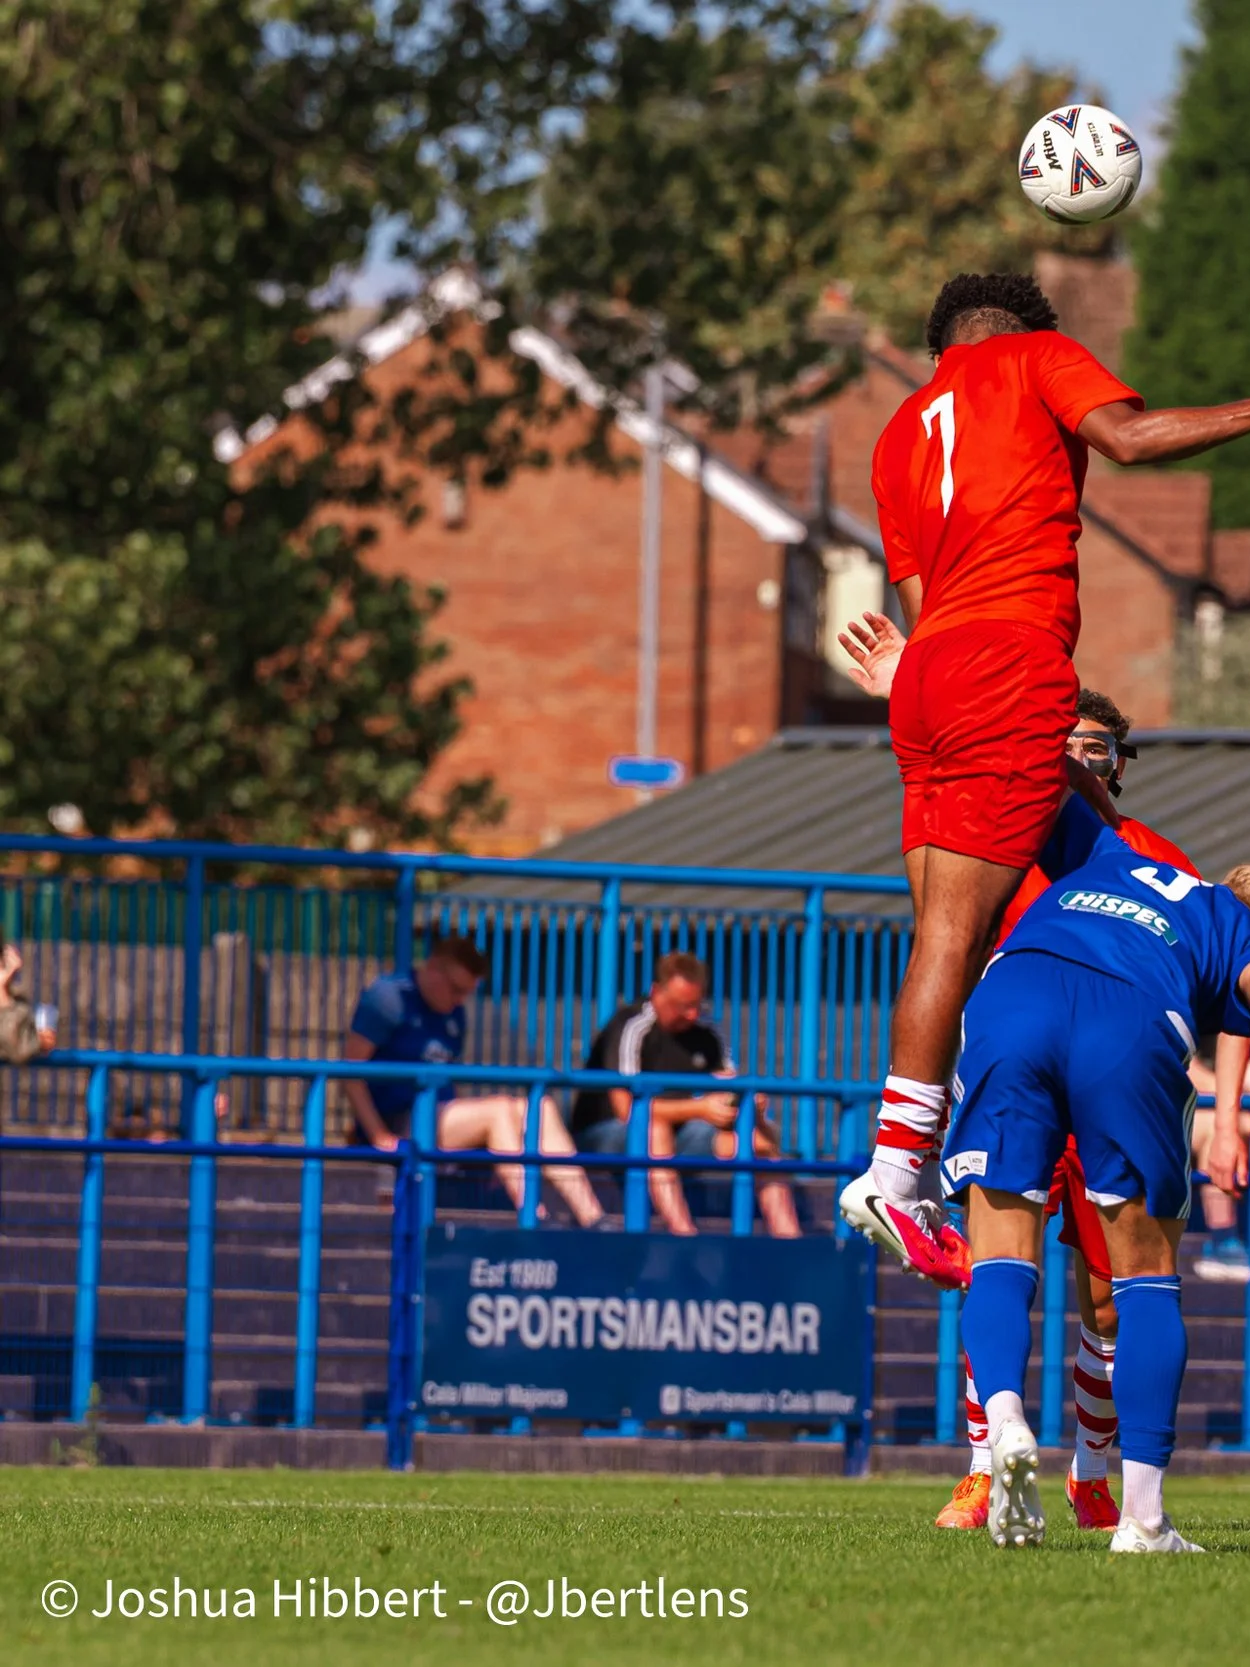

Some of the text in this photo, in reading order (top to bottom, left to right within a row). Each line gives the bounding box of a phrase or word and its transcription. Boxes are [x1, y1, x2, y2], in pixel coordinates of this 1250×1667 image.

[1042, 130, 1063, 172] Mitre
[920, 390, 956, 519] 7
[1067, 891, 1171, 932] HiSPEC
[466, 1293, 821, 1355] SPORTSMANSBAR
